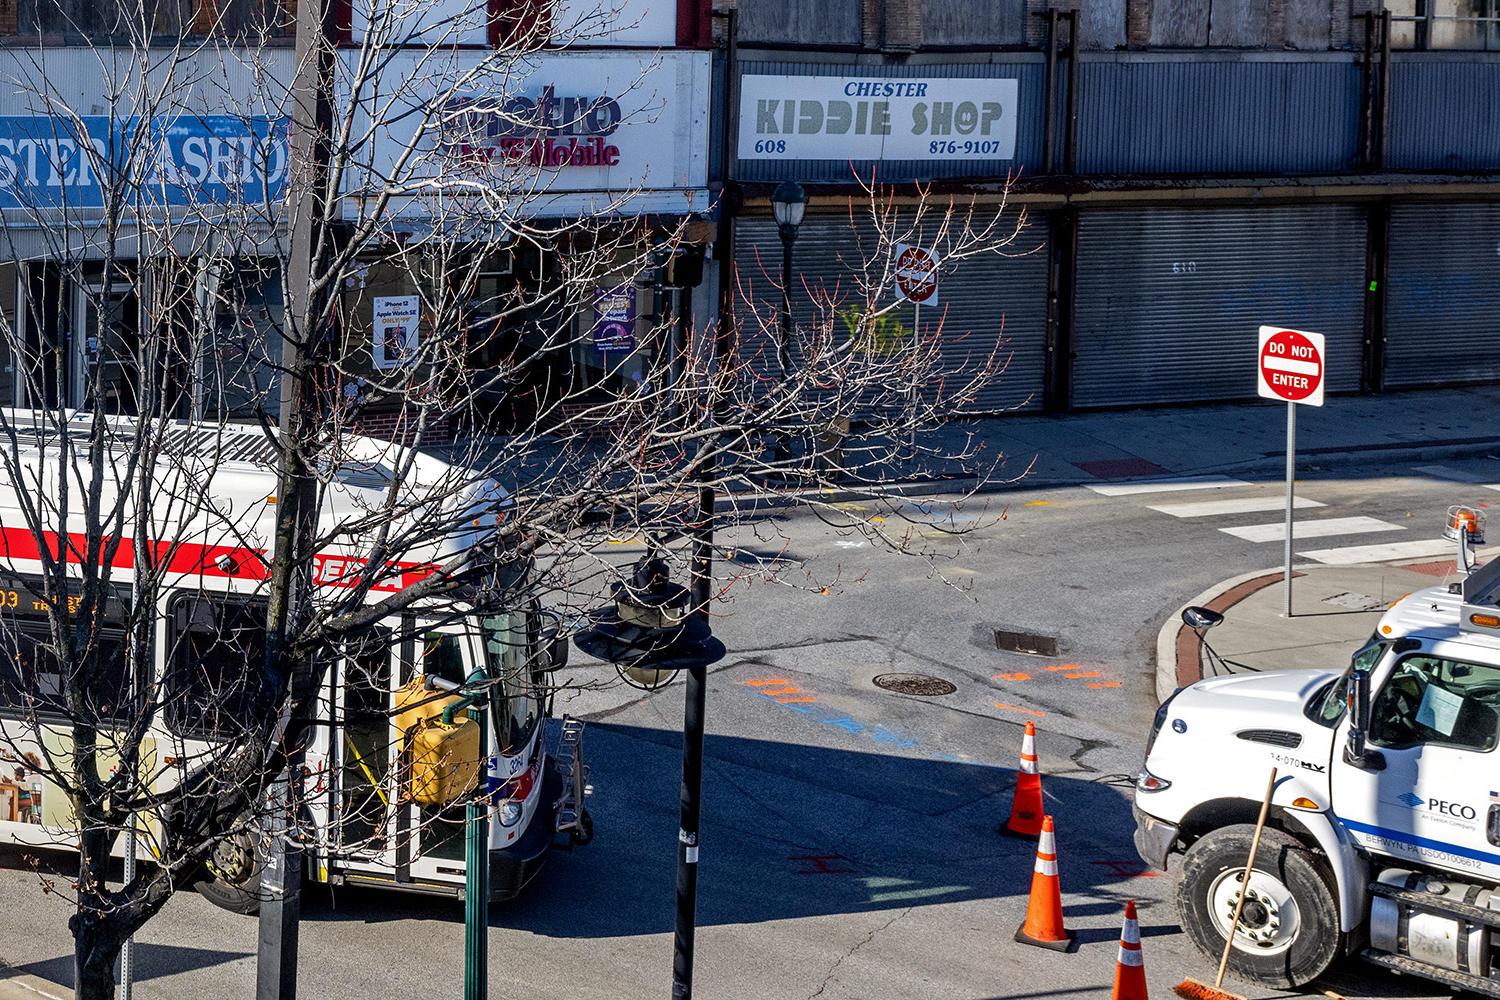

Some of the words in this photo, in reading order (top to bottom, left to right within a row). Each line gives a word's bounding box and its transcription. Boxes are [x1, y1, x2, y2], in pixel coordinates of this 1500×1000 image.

[844, 82, 928, 98] CHESTER
[444, 86, 621, 137] metro
[756, 99, 892, 135] KIDDIE
[911, 101, 1003, 136] SHOP
[754, 140, 786, 154] 608
[929, 140, 1000, 155] 876-9107
[125, 136, 293, 185] ASHIO
[1269, 341, 1285, 355] DO
[1291, 345, 1314, 359] NOT
[1273, 372, 1309, 390] ENTER
[1428, 798, 1476, 820] PECO
[1430, 816, 1449, 825] Exelon
[1449, 819, 1476, 832] Company
[1407, 845, 1419, 854] PA
